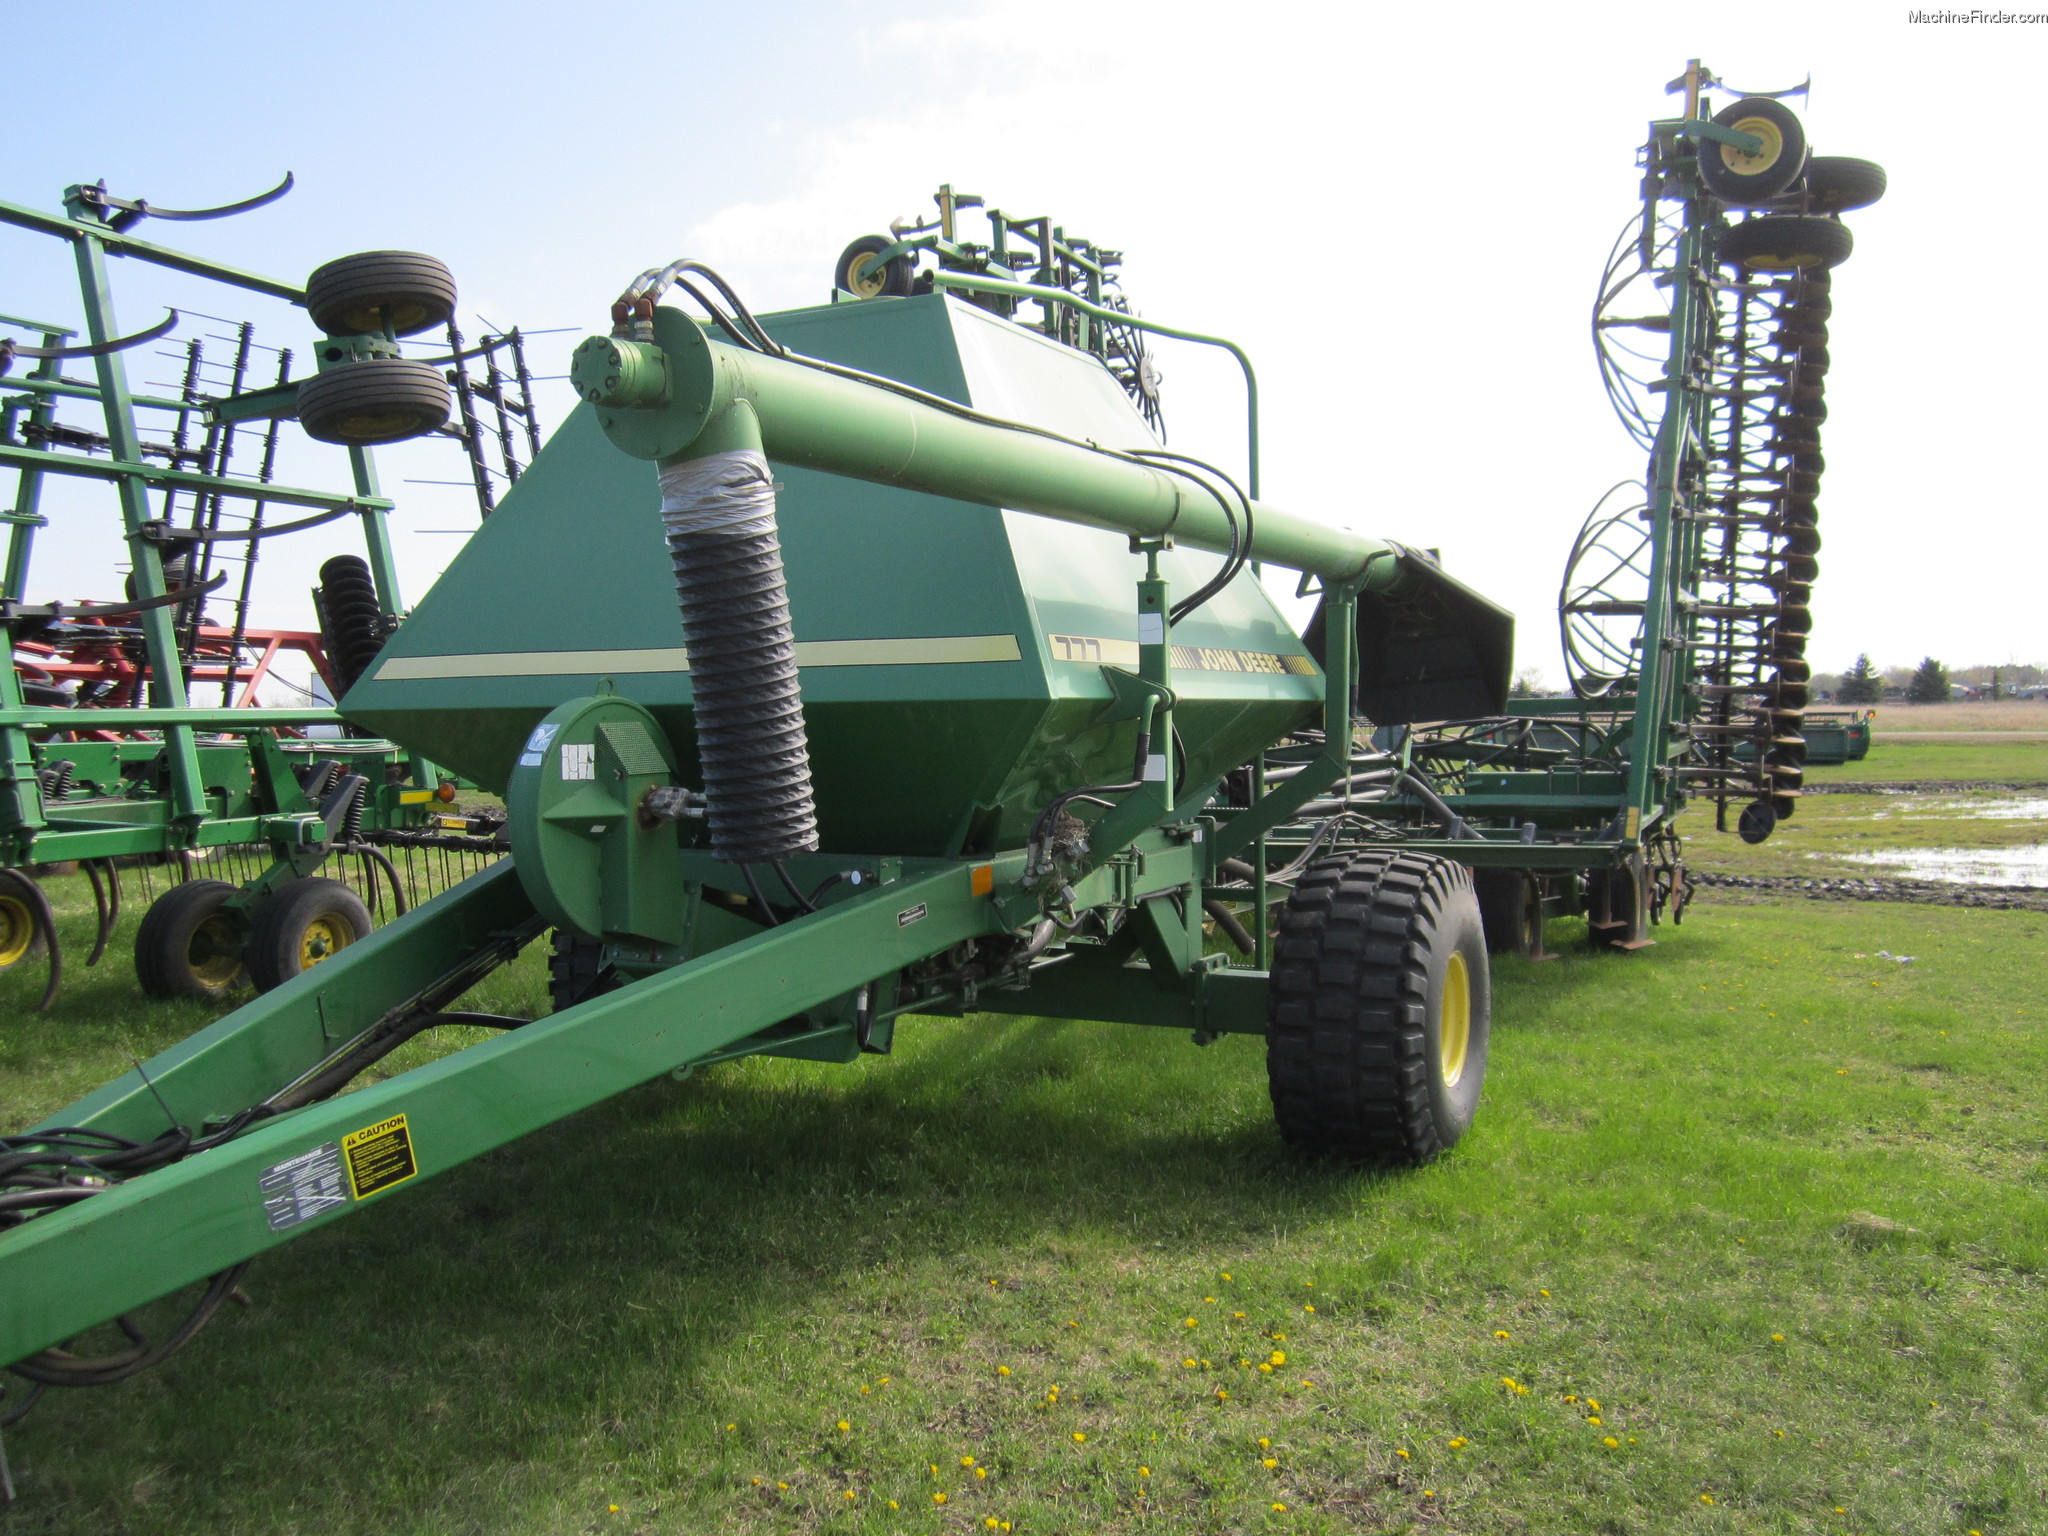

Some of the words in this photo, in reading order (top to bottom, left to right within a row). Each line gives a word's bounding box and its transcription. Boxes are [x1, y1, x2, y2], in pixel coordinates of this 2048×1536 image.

[1054, 635, 1102, 662] 777
[1198, 648, 1242, 671] JOHN
[1237, 651, 1286, 674] DEERE
[358, 1116, 404, 1140] CAUTION
[273, 1148, 323, 1173] MAINTENANCE
